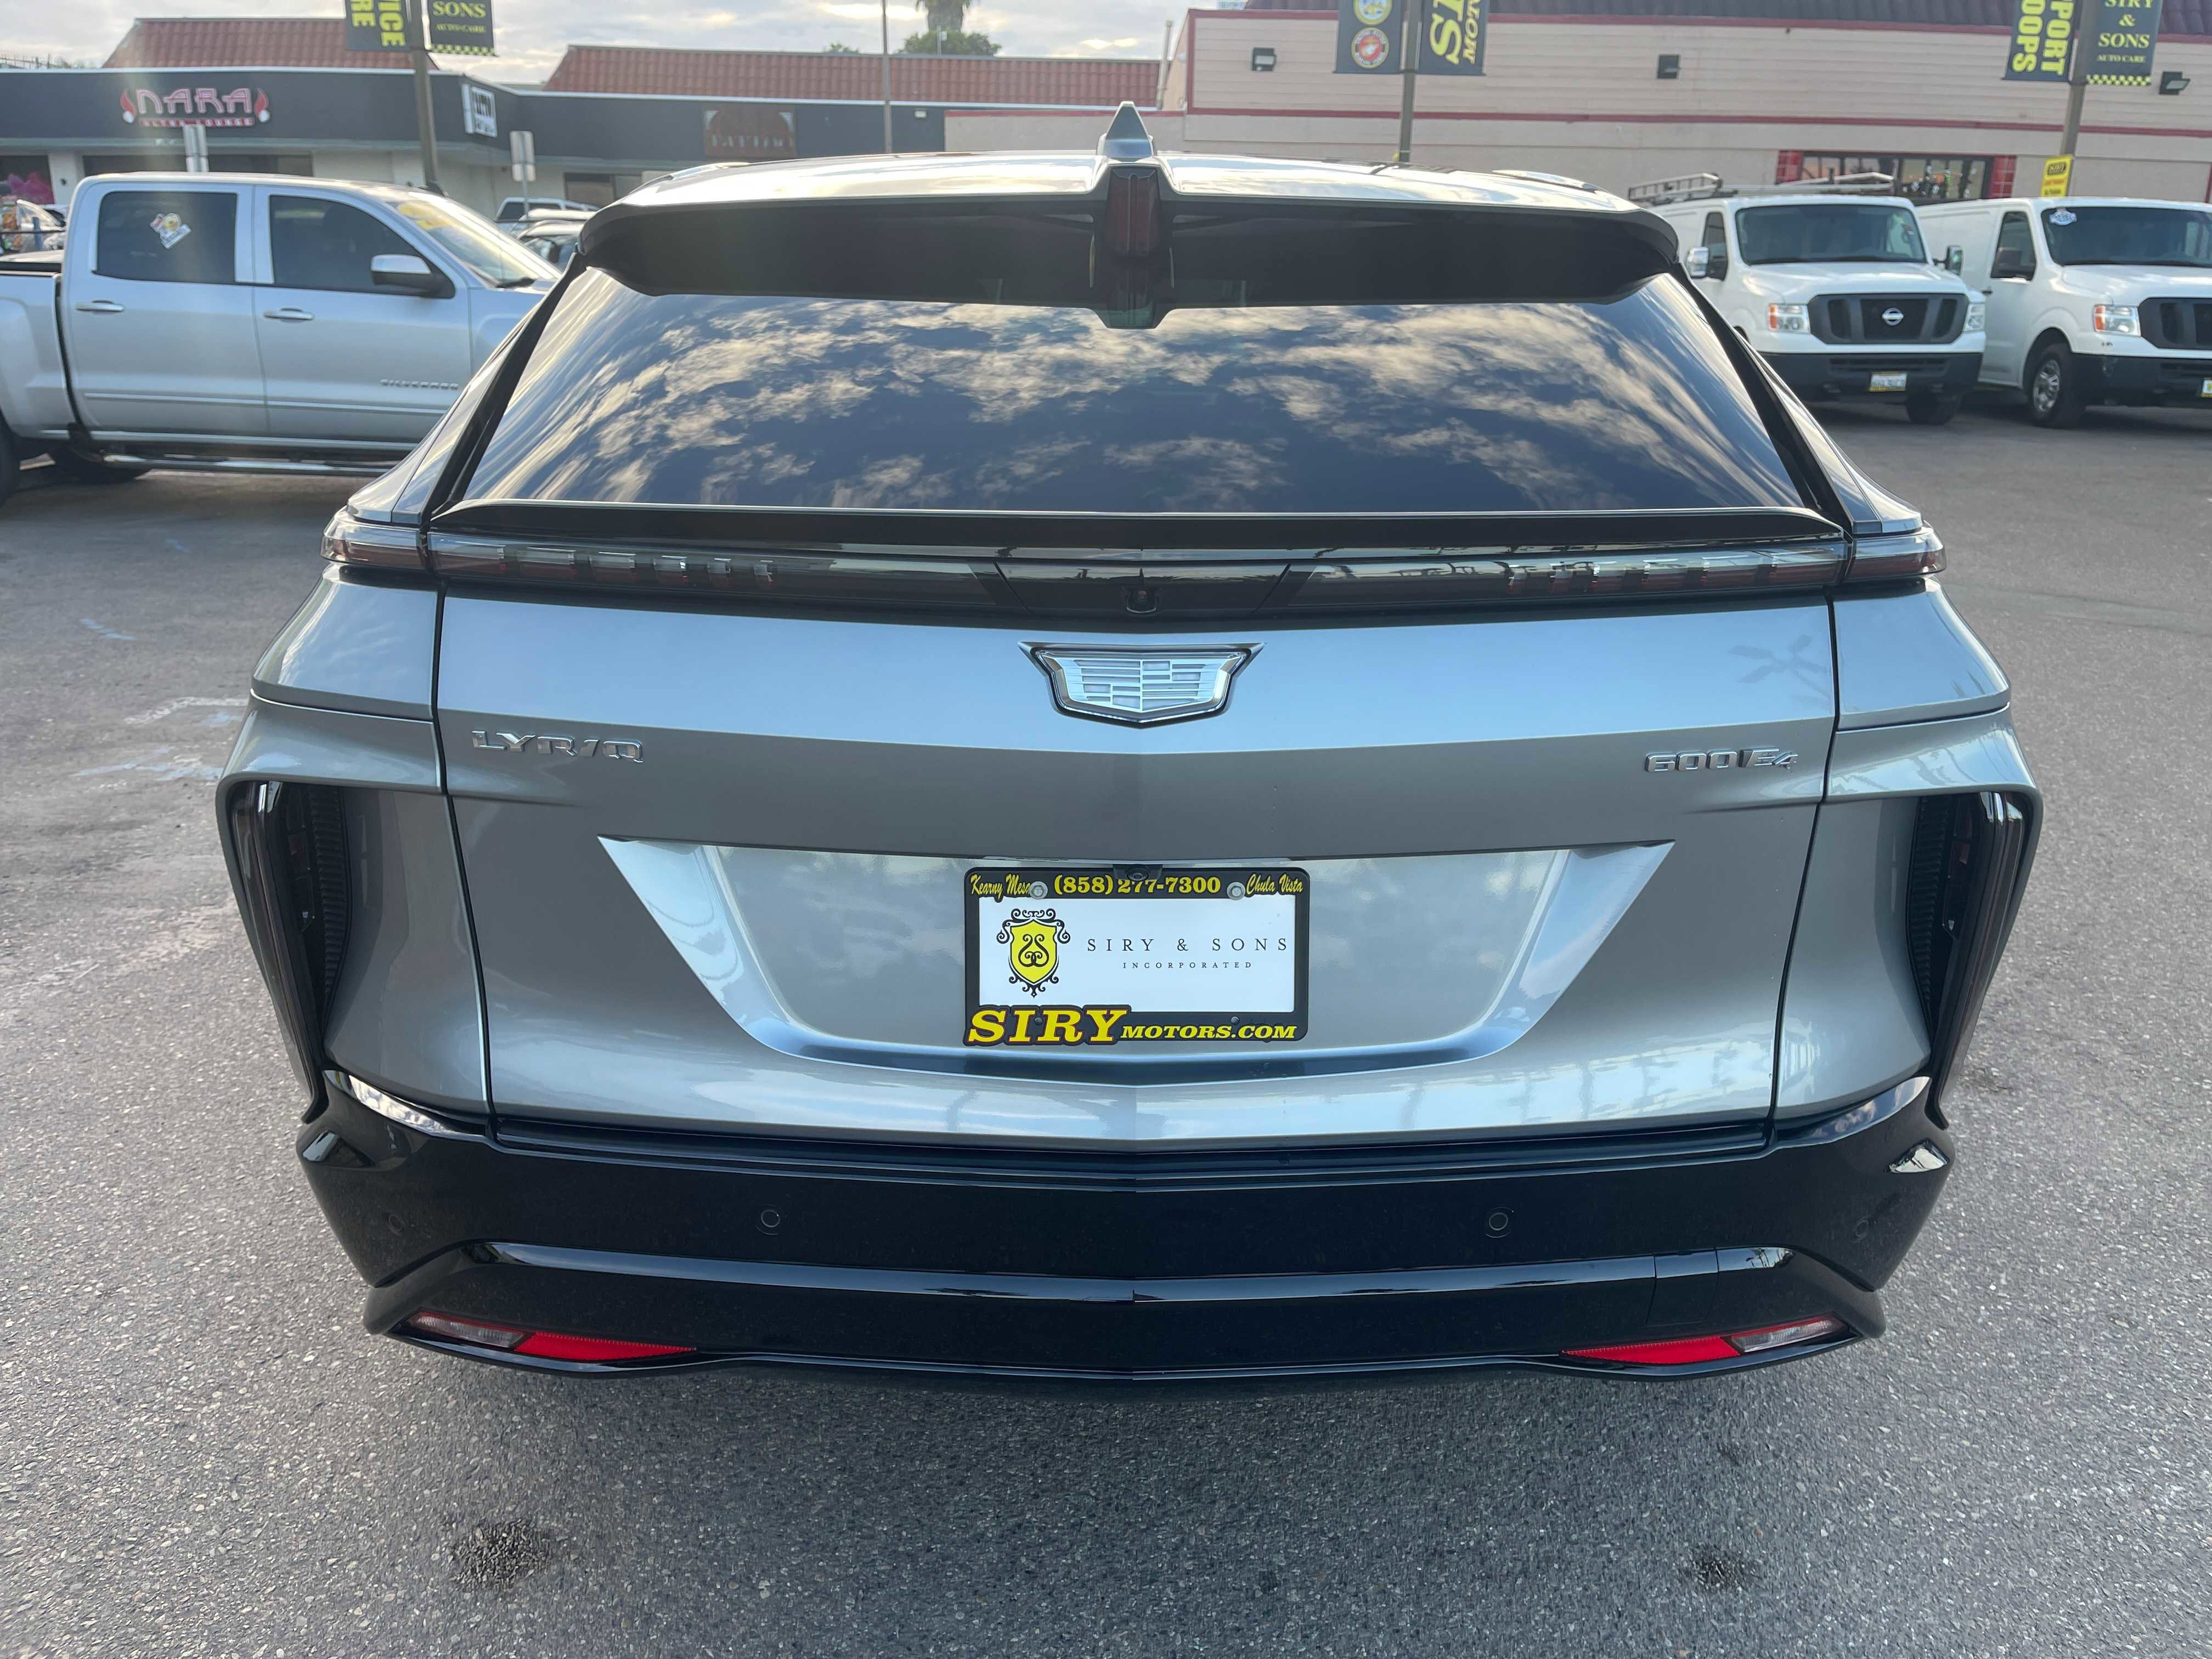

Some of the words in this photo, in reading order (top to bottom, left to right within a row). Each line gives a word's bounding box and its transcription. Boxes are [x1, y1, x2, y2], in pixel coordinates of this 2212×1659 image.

[433, 1, 487, 18] SONS
[2119, 14, 2136, 27] &
[377, 0, 405, 47] ICE
[1463, 0, 1481, 65] MOT
[2040, 0, 2074, 76] PORT
[2097, 32, 2150, 49] SONS
[2097, 54, 2121, 62] AUTO
[2121, 55, 2146, 63] CARE
[470, 729, 644, 764] LYRIQ
[970, 874, 1003, 900] Kearny
[1054, 874, 1114, 895] (858)
[1118, 877, 1221, 894] 277-7300
[1246, 874, 1276, 895] Chula
[1279, 873, 1304, 893] Vista
[1087, 938, 1154, 952] SIRY
[1177, 938, 1189, 952] &
[1211, 938, 1287, 952] SONS
